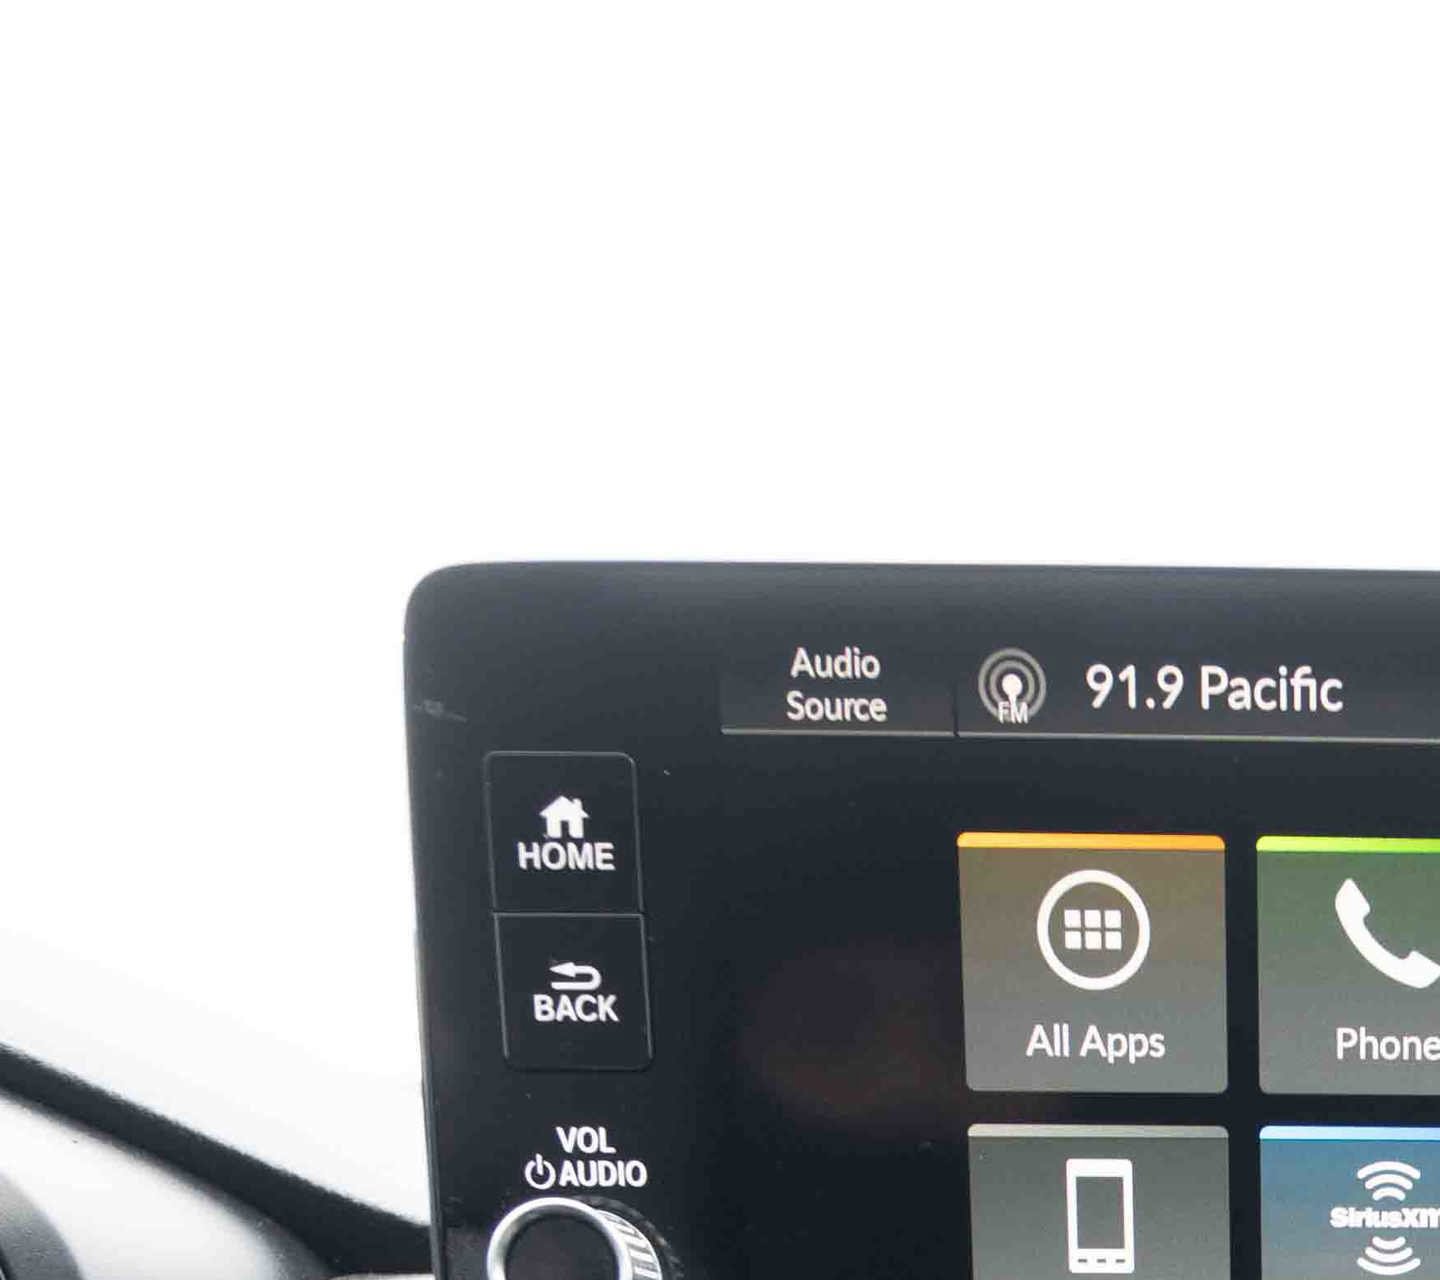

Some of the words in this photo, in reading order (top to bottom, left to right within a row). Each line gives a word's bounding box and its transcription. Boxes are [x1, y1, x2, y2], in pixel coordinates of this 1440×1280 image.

[790, 646, 881, 681] Audio
[1085, 663, 1184, 711] 91.9
[1200, 665, 1345, 713] Pacific
[786, 691, 887, 724] Source
[997, 700, 1029, 724] FM
[517, 841, 615, 872] HOME
[533, 993, 620, 1023] BACK
[1026, 1024, 1070, 1058] All
[1080, 1024, 1166, 1064] Apps
[556, 1126, 616, 1155] VOL
[559, 1160, 647, 1188] AUDIO
